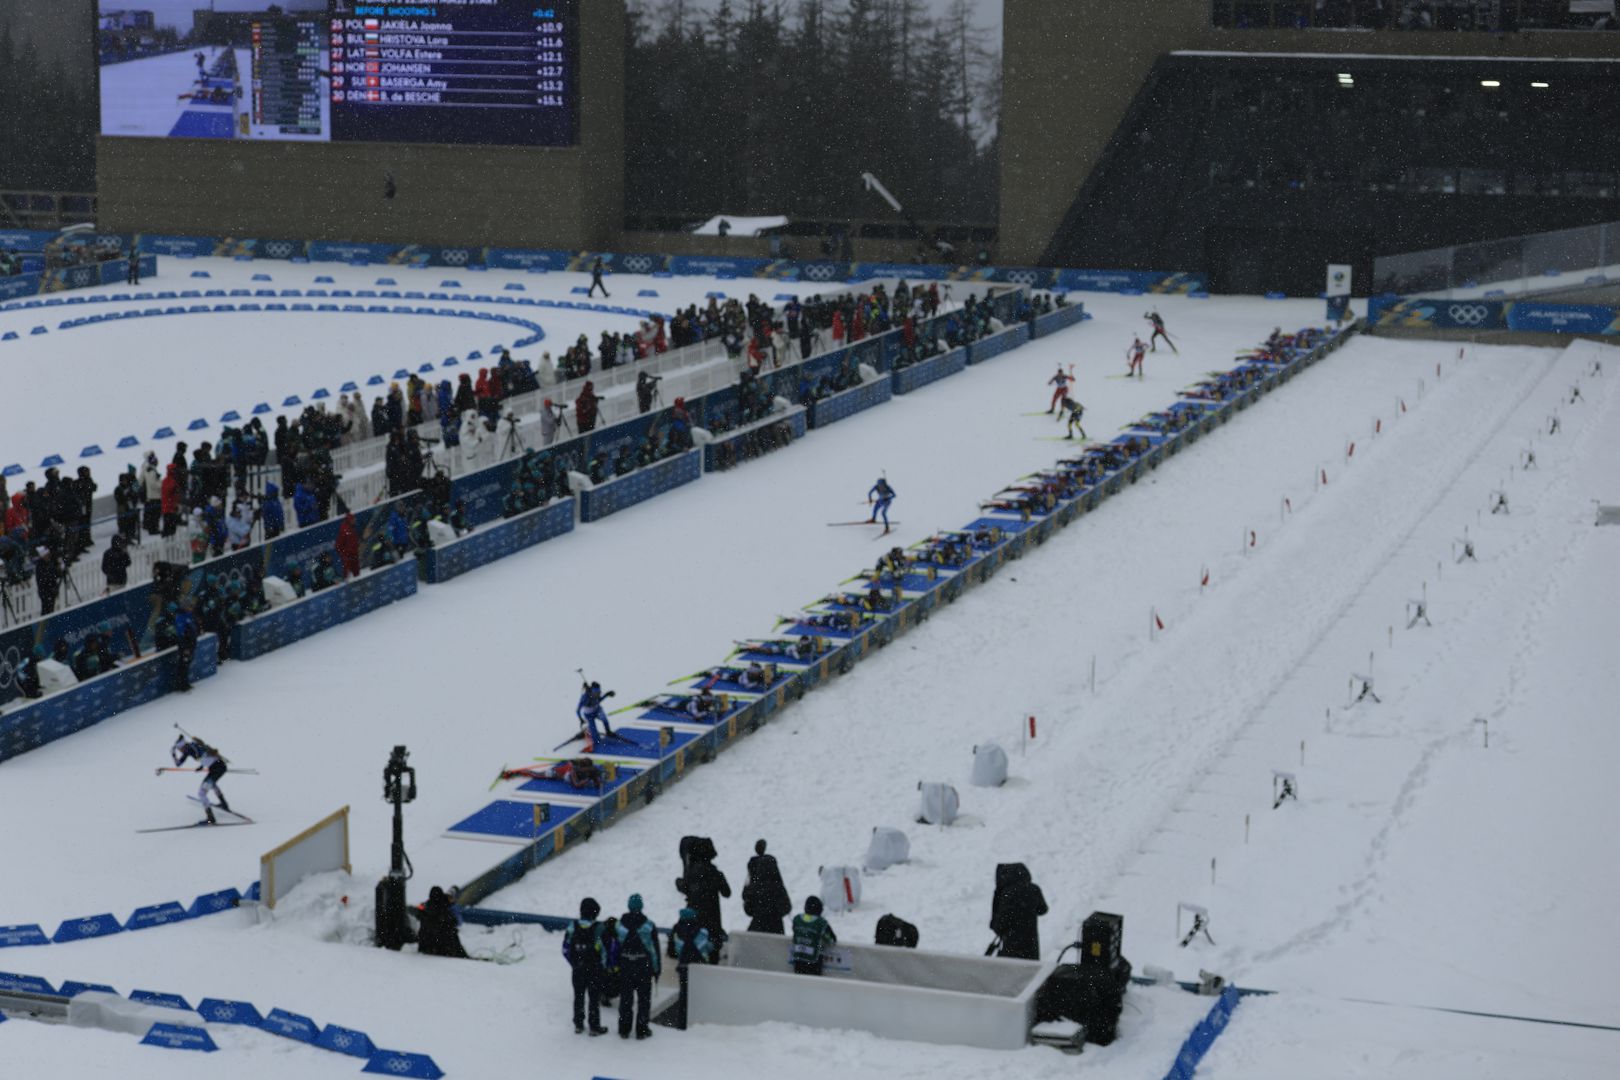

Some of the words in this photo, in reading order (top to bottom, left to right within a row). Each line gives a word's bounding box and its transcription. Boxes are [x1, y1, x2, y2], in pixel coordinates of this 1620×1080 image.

[346, 19, 364, 30] POL
[347, 34, 364, 45] BUL
[380, 34, 426, 45] HRISTOVA
[347, 48, 365, 59] LAT
[381, 48, 413, 59] VOLFA
[346, 62, 365, 73] NOR
[382, 62, 431, 73] JOHANSEN
[380, 77, 425, 88] BASERGA
[426, 78, 448, 91] Amy
[347, 90, 367, 101] DEN
